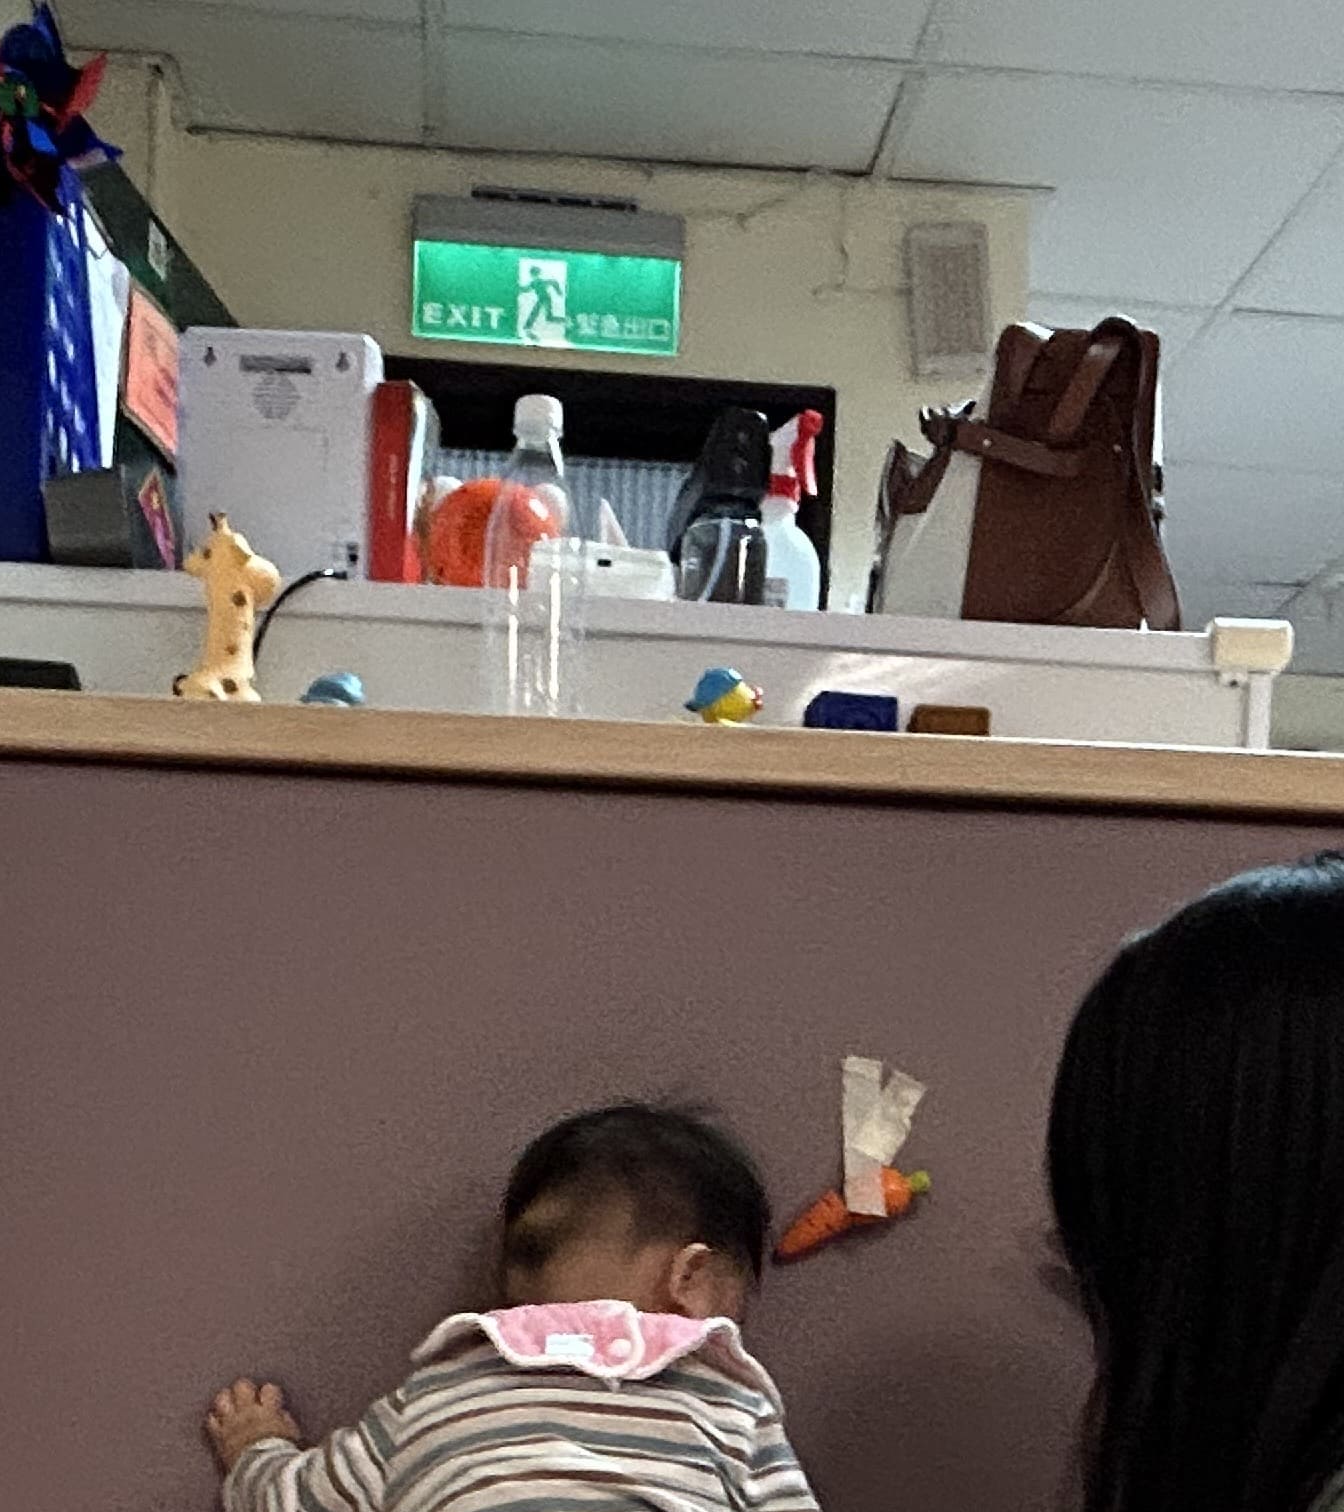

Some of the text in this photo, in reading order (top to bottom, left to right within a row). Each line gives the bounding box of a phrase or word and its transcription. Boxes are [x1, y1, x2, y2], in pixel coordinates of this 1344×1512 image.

[423, 302, 504, 330] EXIT
[575, 312, 672, 342] 緊急出口
